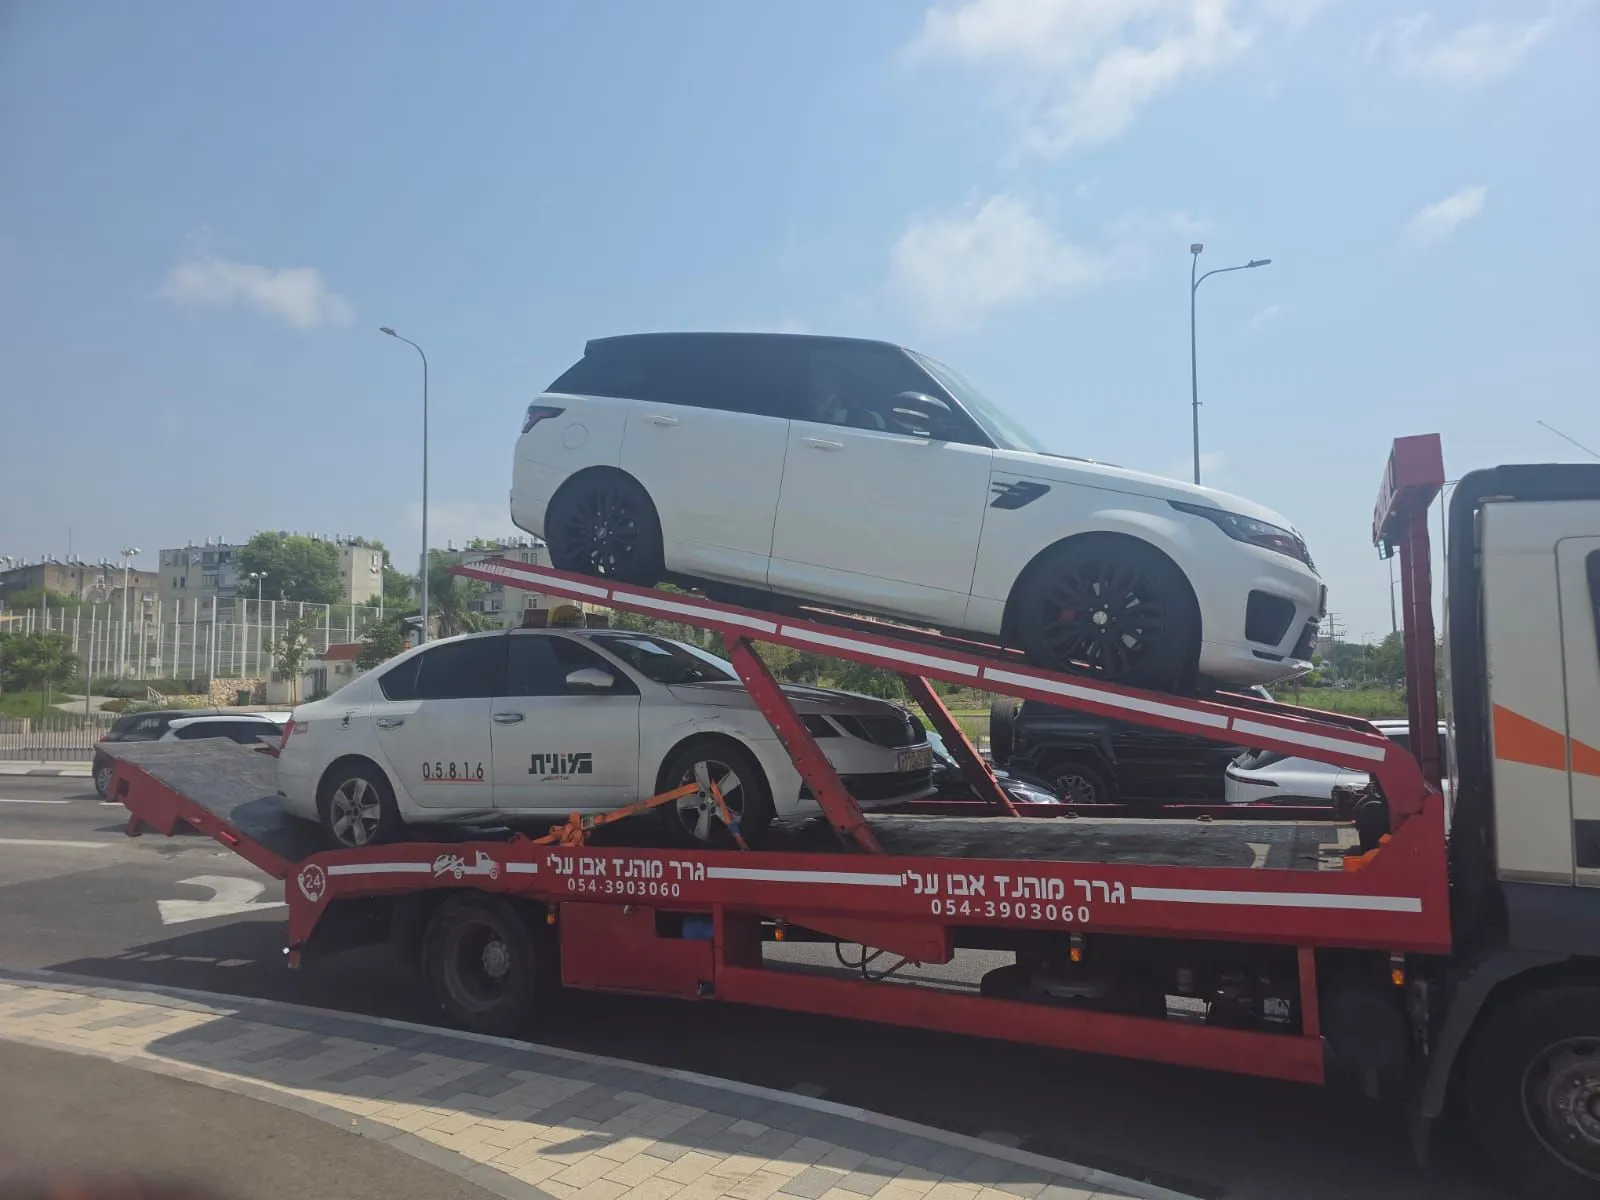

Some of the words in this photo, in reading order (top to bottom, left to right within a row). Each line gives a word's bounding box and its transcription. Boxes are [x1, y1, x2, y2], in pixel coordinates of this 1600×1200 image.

[422, 761, 484, 780] 05816
[546, 853, 574, 875] עלי
[579, 857, 607, 876] אבו
[612, 858, 663, 879] מוהנד
[669, 860, 705, 881] גרר
[305, 873, 321, 889] 24
[567, 878, 680, 897] 054-3903060
[901, 870, 939, 895] עלי
[947, 874, 986, 897] אבו
[994, 875, 1065, 900] מוהנד
[1074, 879, 1126, 904] גרר
[931, 899, 1090, 922] 054-3903060
